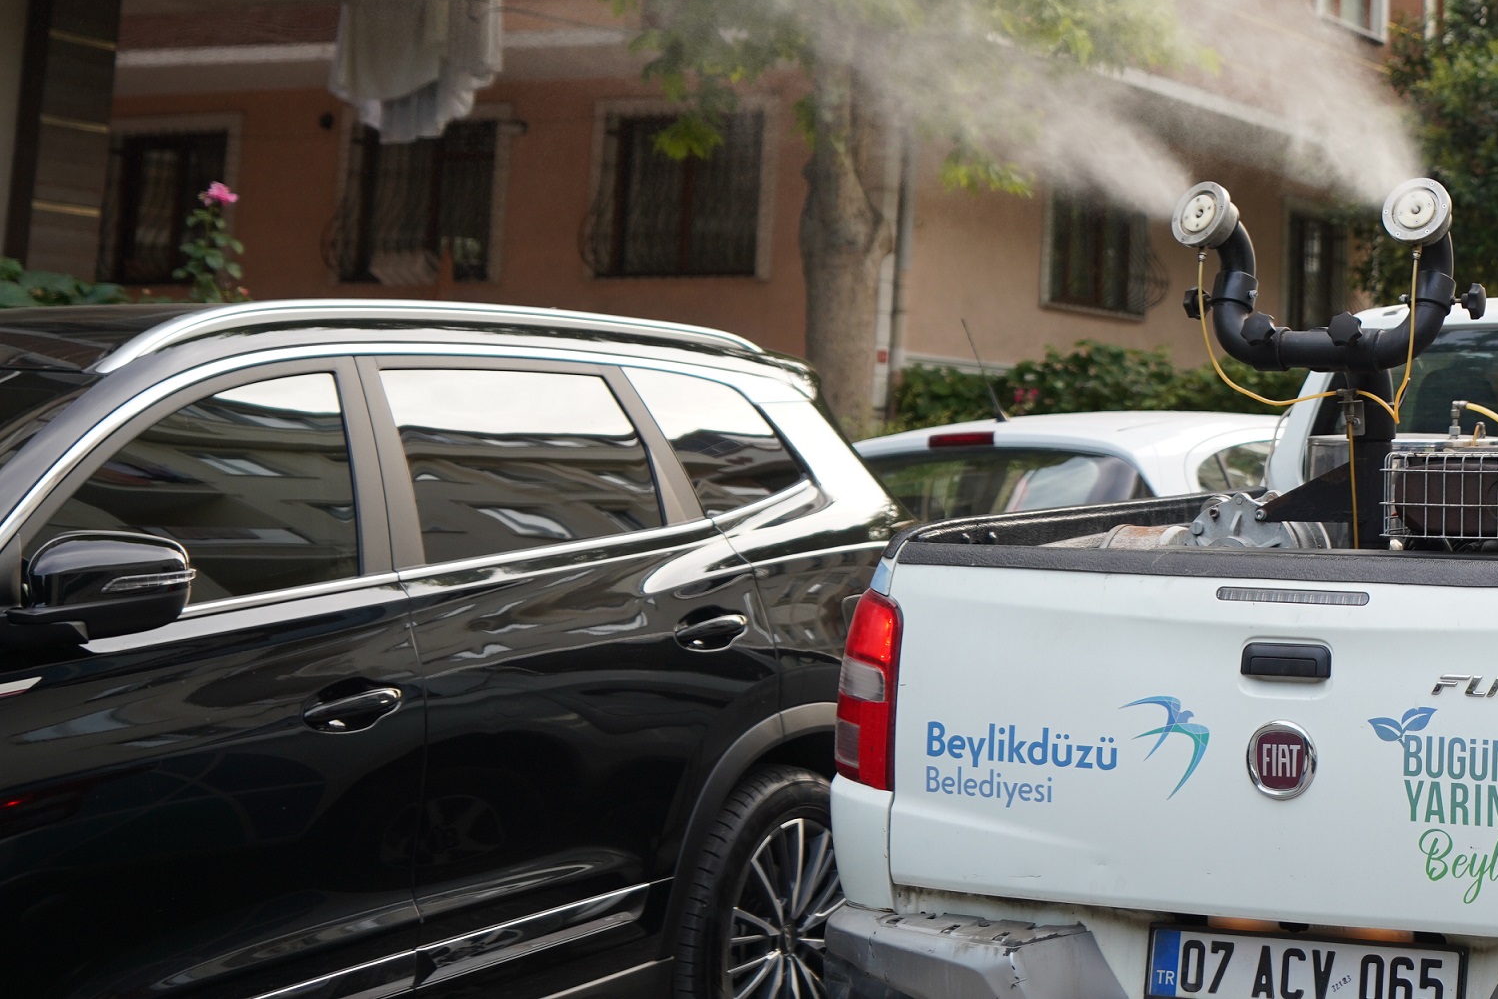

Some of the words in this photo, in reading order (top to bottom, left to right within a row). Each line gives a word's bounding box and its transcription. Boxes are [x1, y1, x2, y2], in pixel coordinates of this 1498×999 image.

[926, 721, 1118, 771] Beylikdüzü
[1262, 744, 1301, 777] FIAT
[926, 765, 1053, 808] Belediyesi
[1156, 970, 1175, 986] TR
[1180, 939, 1235, 994] 07
[1251, 945, 1336, 999] ACV
[1359, 954, 1444, 999] 065
